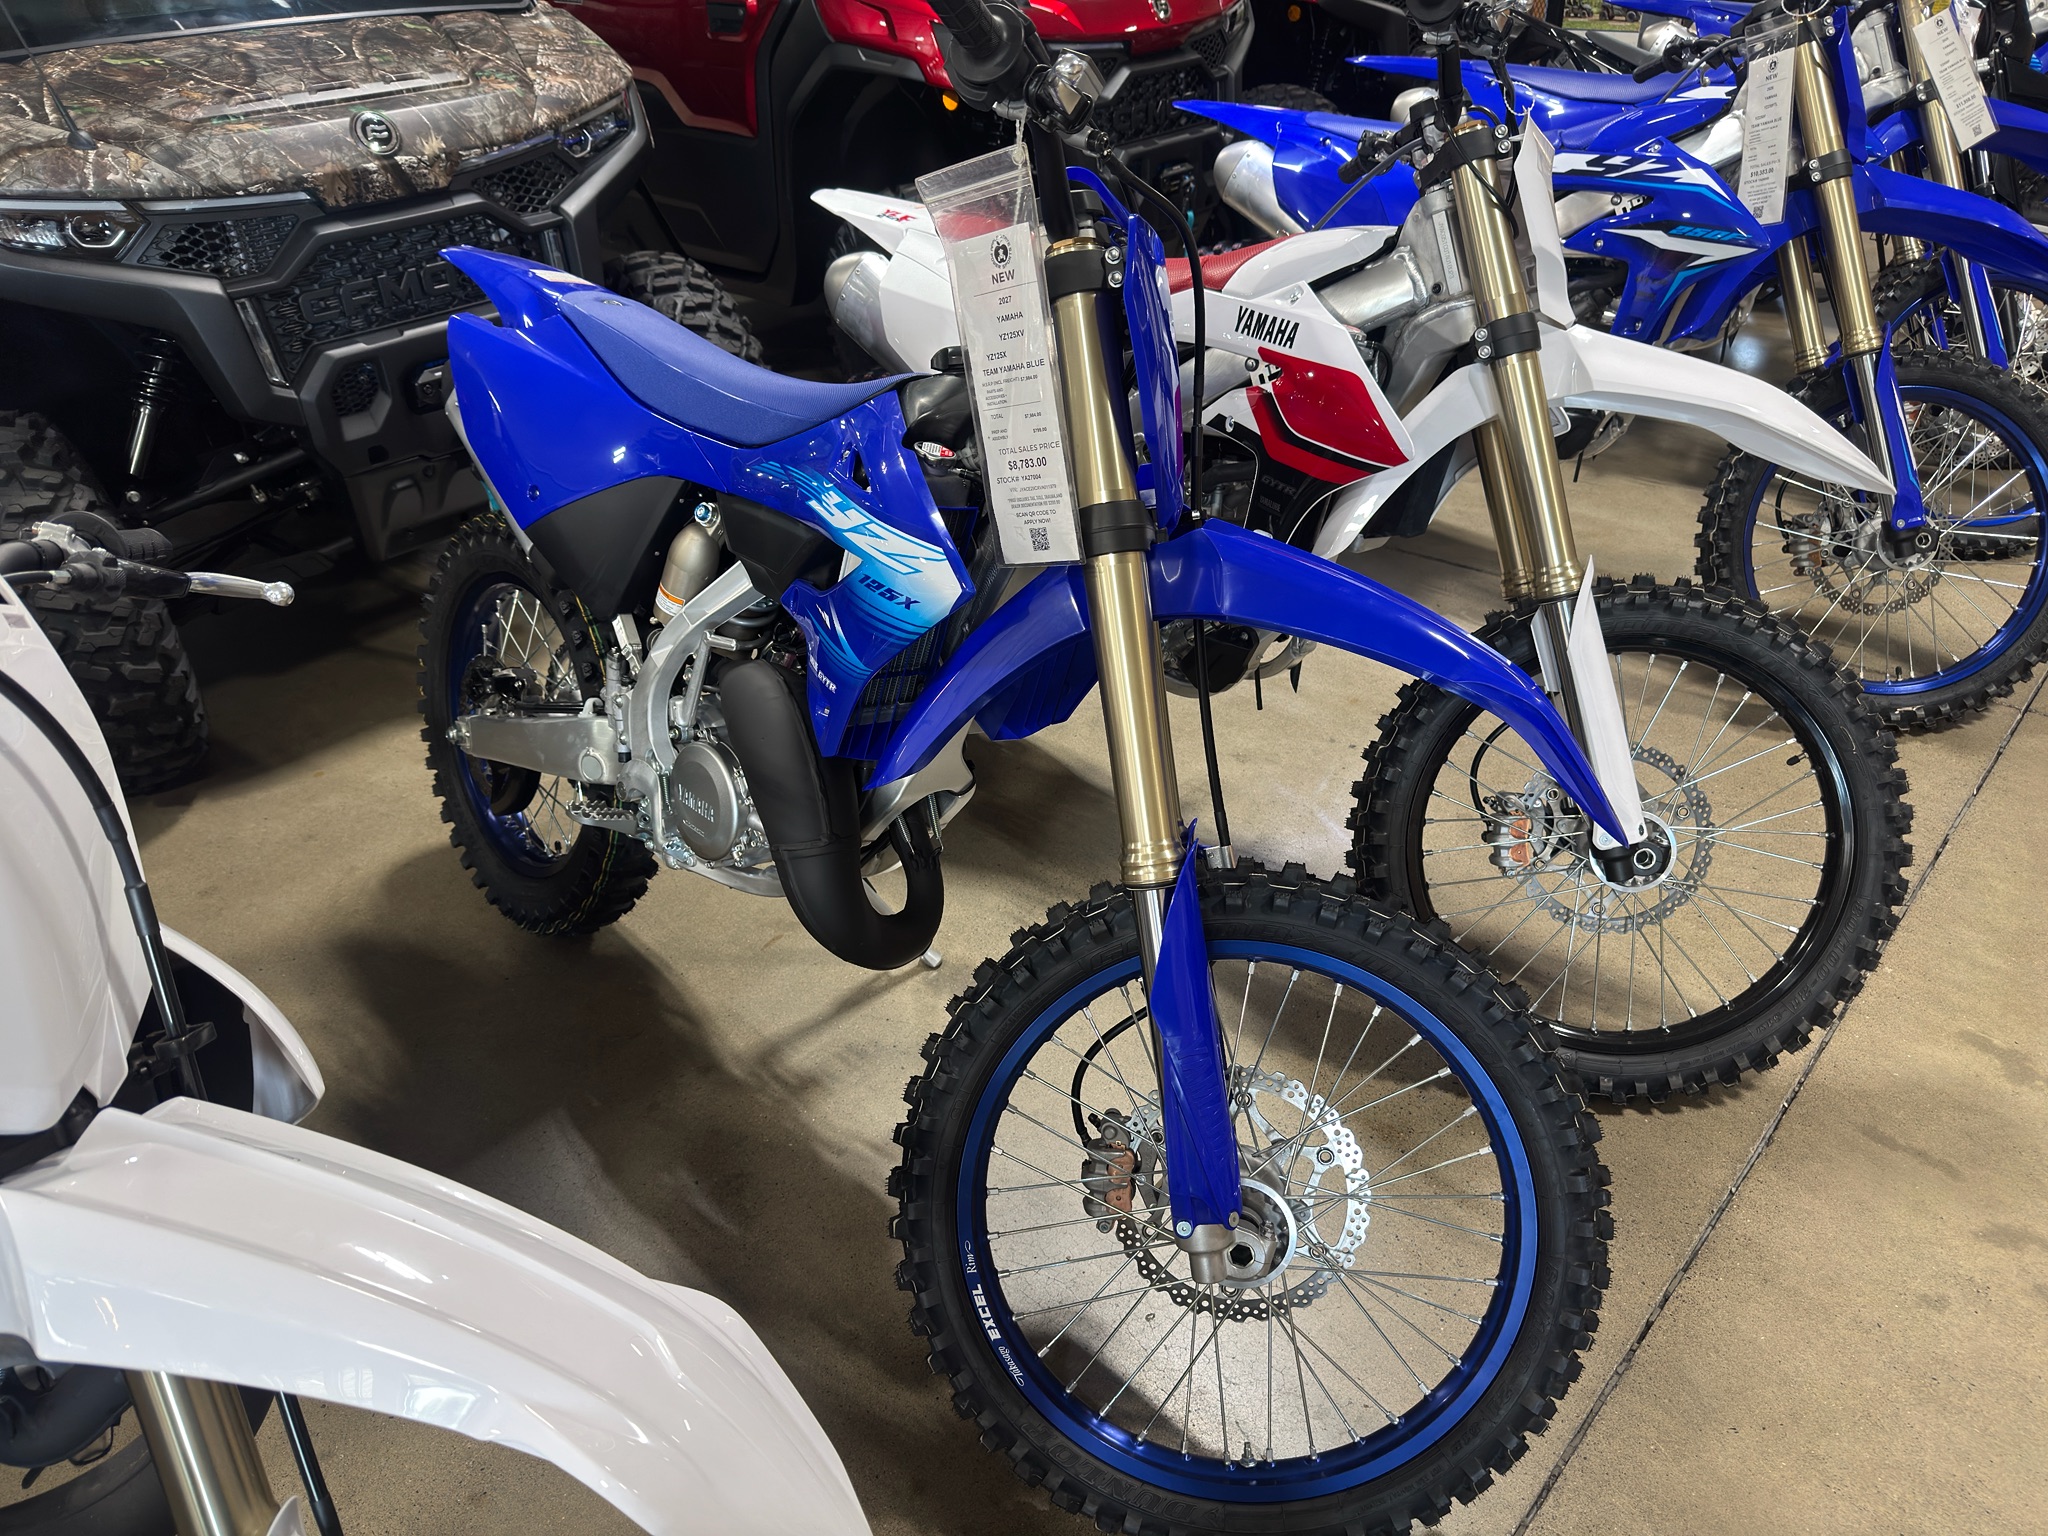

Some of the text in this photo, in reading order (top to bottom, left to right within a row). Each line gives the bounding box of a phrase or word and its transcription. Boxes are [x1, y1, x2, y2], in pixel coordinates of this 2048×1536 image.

[1668, 225, 1752, 241] 250F
[991, 269, 1015, 285] NEW
[998, 296, 1012, 305] 2027
[996, 312, 1023, 323] YAMAHA
[999, 329, 1024, 341] YZ125XV
[1235, 306, 1300, 349] YAMAHA
[986, 351, 1007, 361] YZ125X
[983, 359, 1045, 376] TEAM YAMAHA BLUE
[1018, 444, 1037, 453] SALES
[1039, 441, 1060, 449] PRICE
[1008, 457, 1047, 471] $8,783.00
[997, 476, 1019, 484] STOCK#
[1262, 475, 1297, 496] GYTR
[856, 574, 921, 610] 125X
[818, 670, 837, 694] GYTR
[678, 784, 714, 823] YAMAHA
[965, 1240, 1025, 1386] Takasago EXCEL Rim
[1020, 1422, 1198, 1522] DUNLOP
